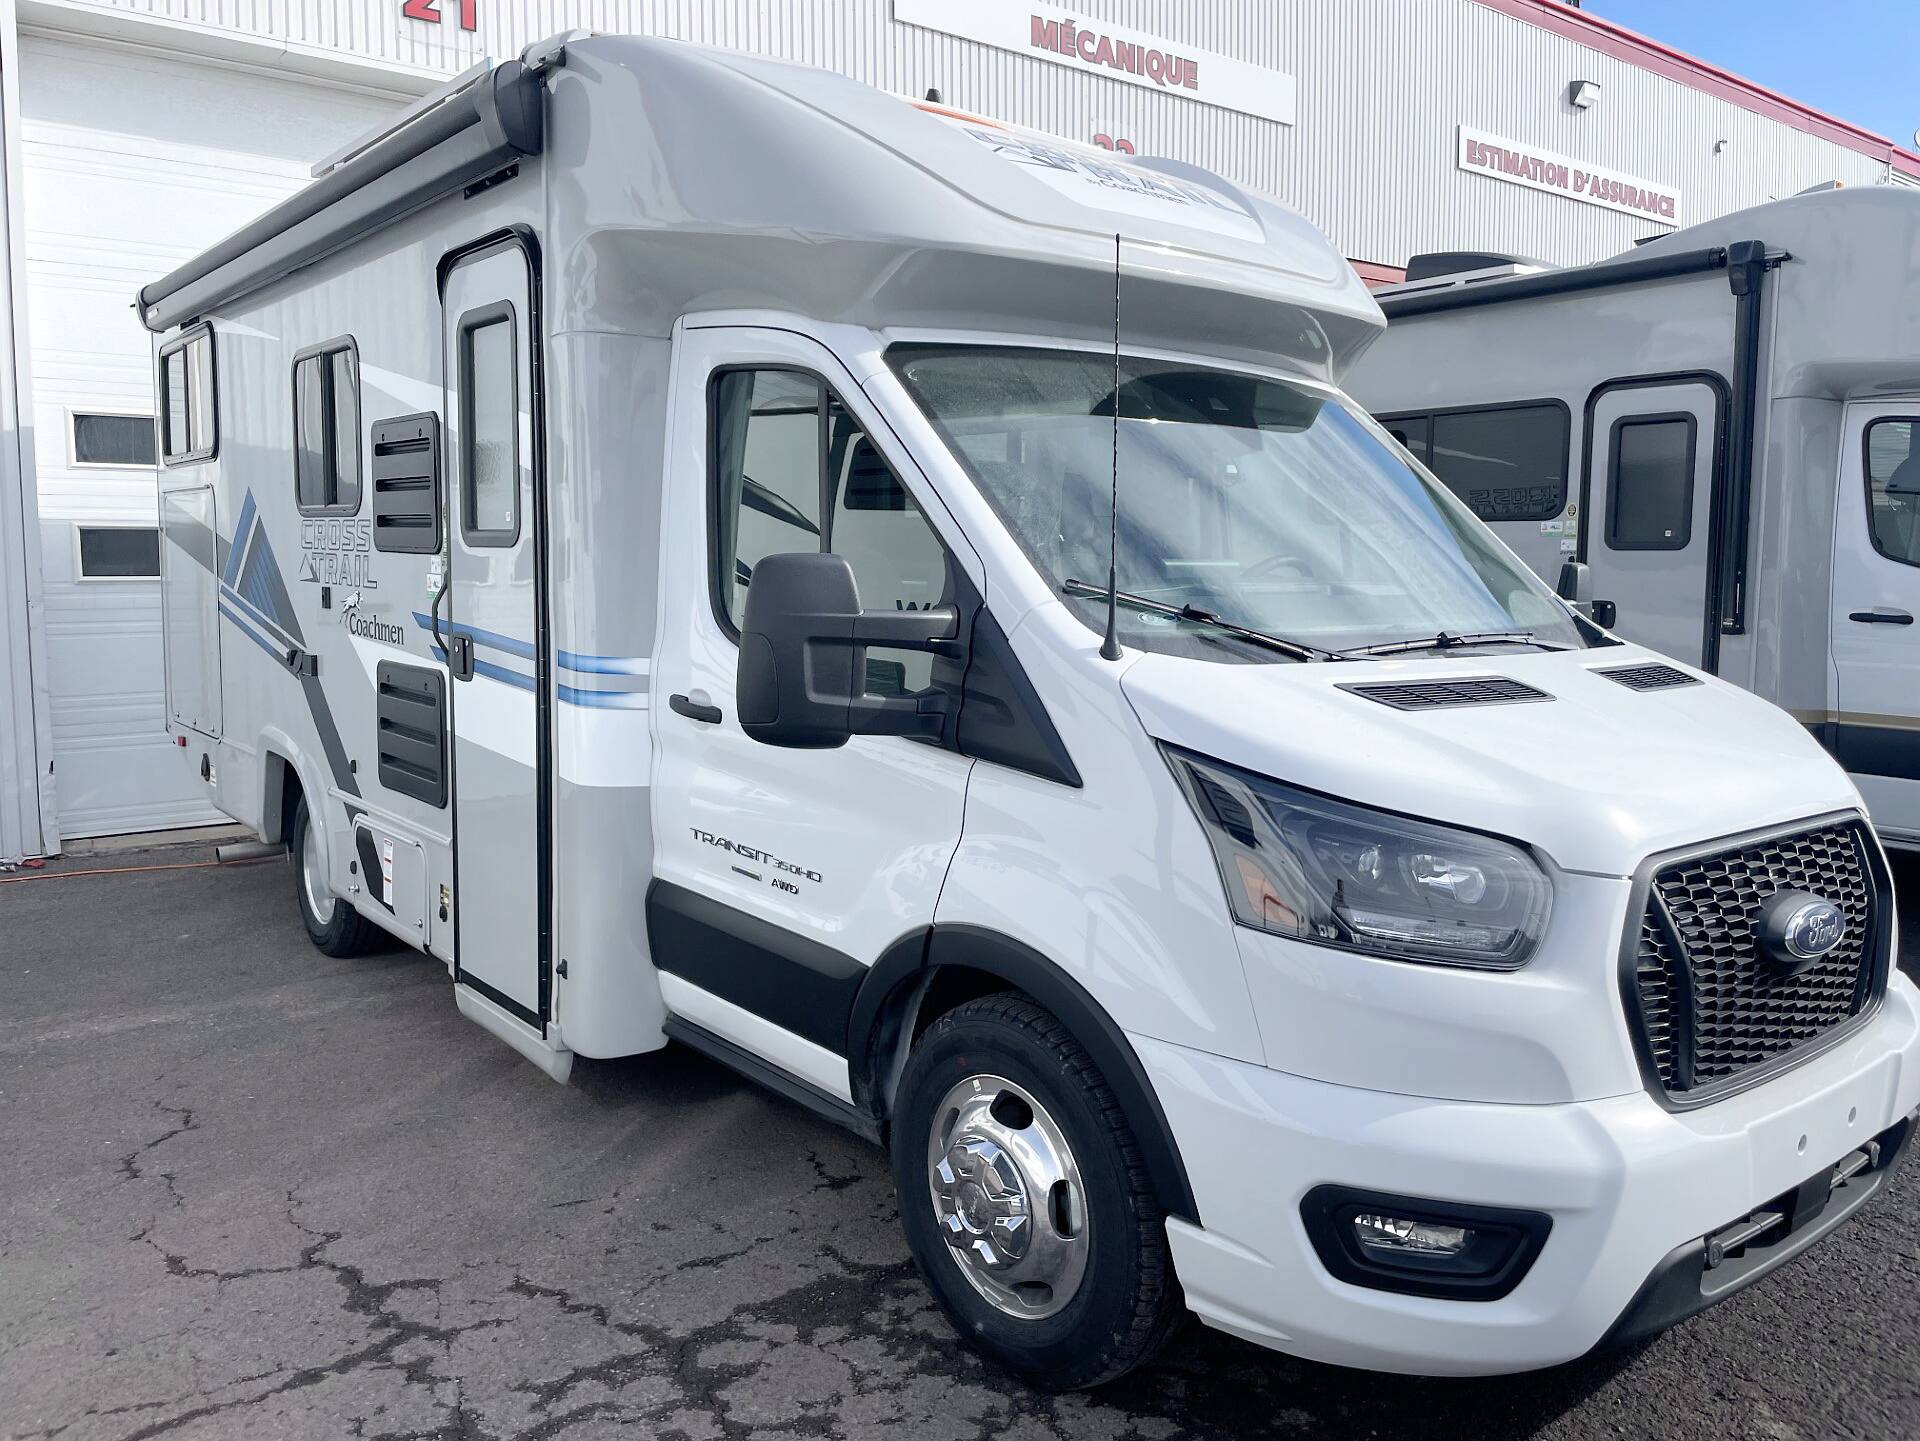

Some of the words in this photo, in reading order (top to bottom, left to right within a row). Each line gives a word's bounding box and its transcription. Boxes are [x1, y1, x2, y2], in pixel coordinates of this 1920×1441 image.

[1030, 14, 1198, 91] MÉCANIQUE
[1466, 138, 1569, 189] ESTIMATION
[1573, 169, 1675, 218] D'ASSURANCE
[301, 519, 371, 552] CROSS
[311, 552, 378, 589] TRAIL
[349, 611, 405, 646] Coachmen
[689, 827, 774, 864] TRANSIT
[771, 878, 799, 895] AWD
[1809, 913, 1839, 946] Ford
